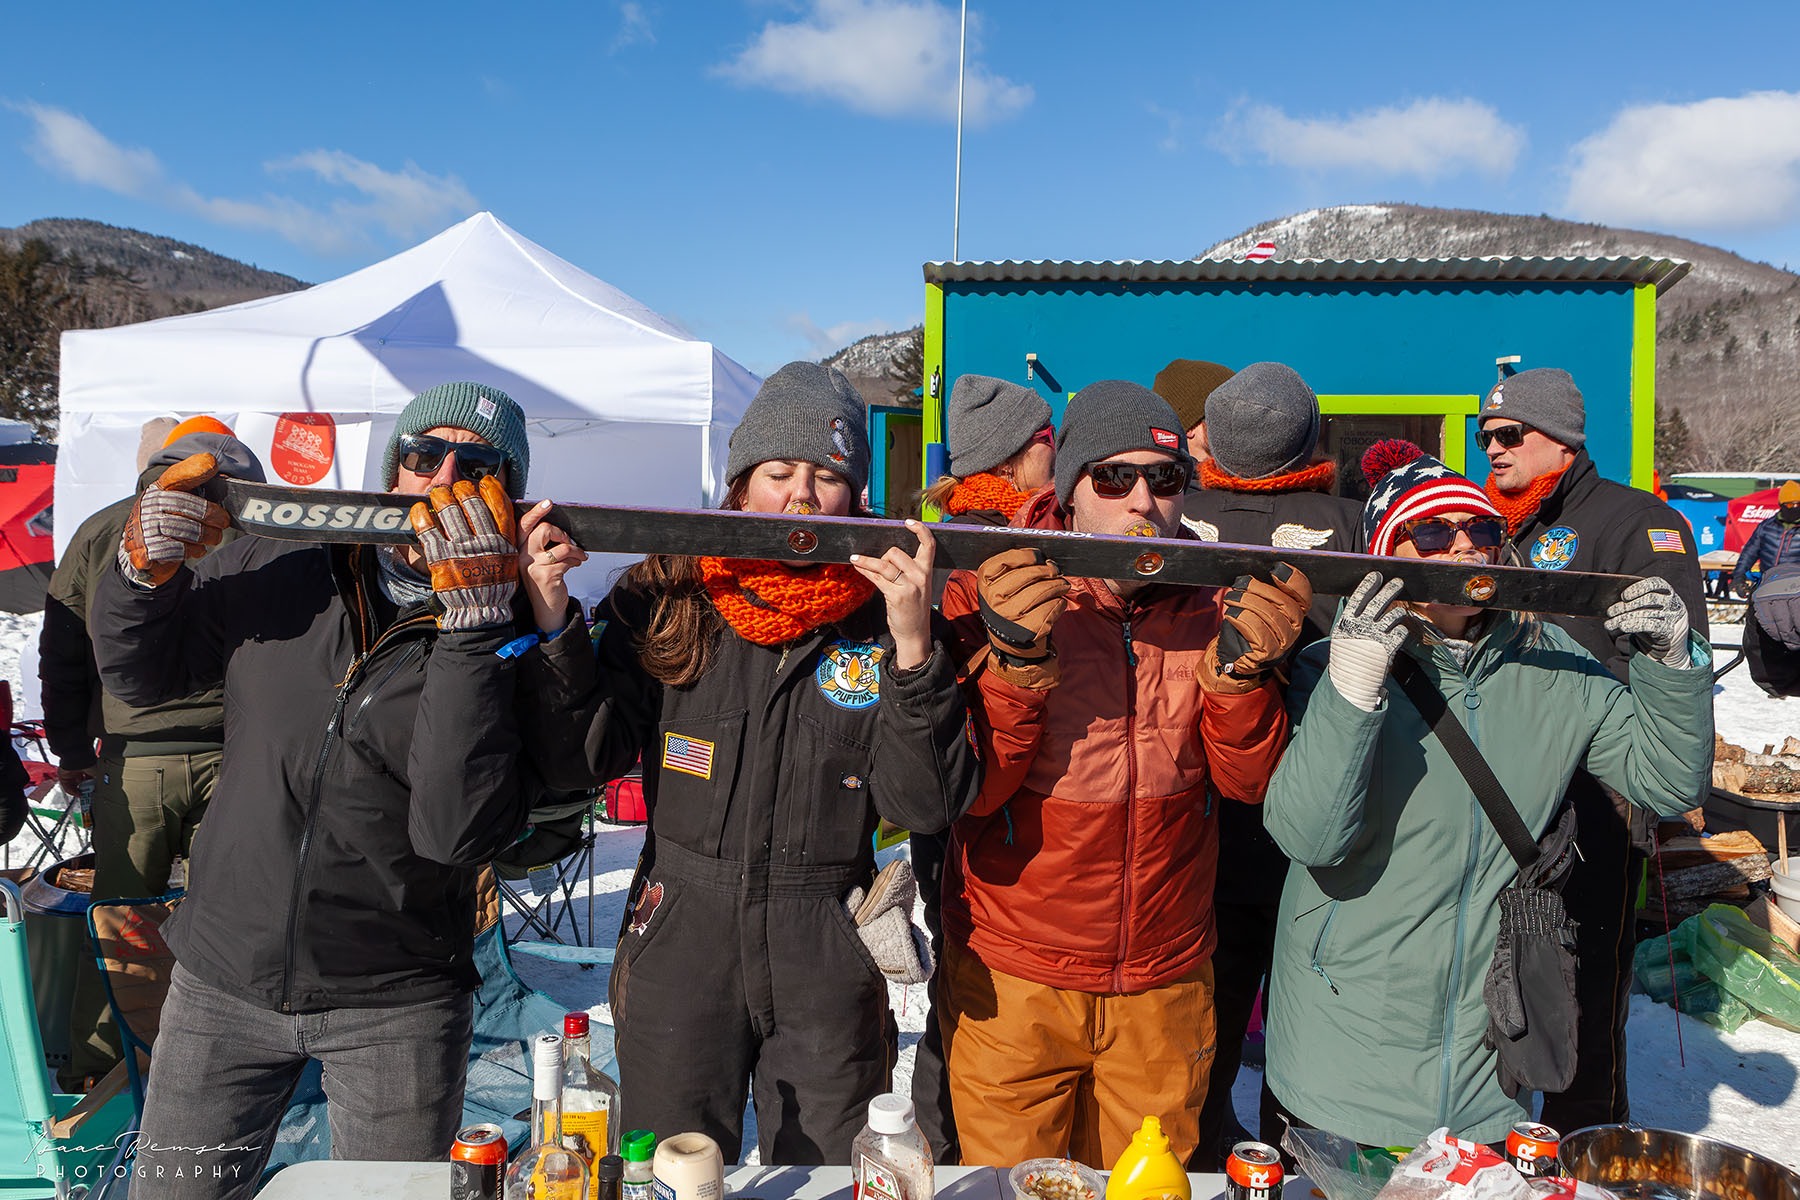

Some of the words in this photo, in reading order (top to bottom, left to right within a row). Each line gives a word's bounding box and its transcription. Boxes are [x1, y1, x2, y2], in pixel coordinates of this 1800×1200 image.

[283, 471, 313, 484] 2025
[983, 526, 1095, 538] ROSSIGNOL
[461, 564, 504, 579] KINCO
[832, 690, 875, 705] PUFFINS
